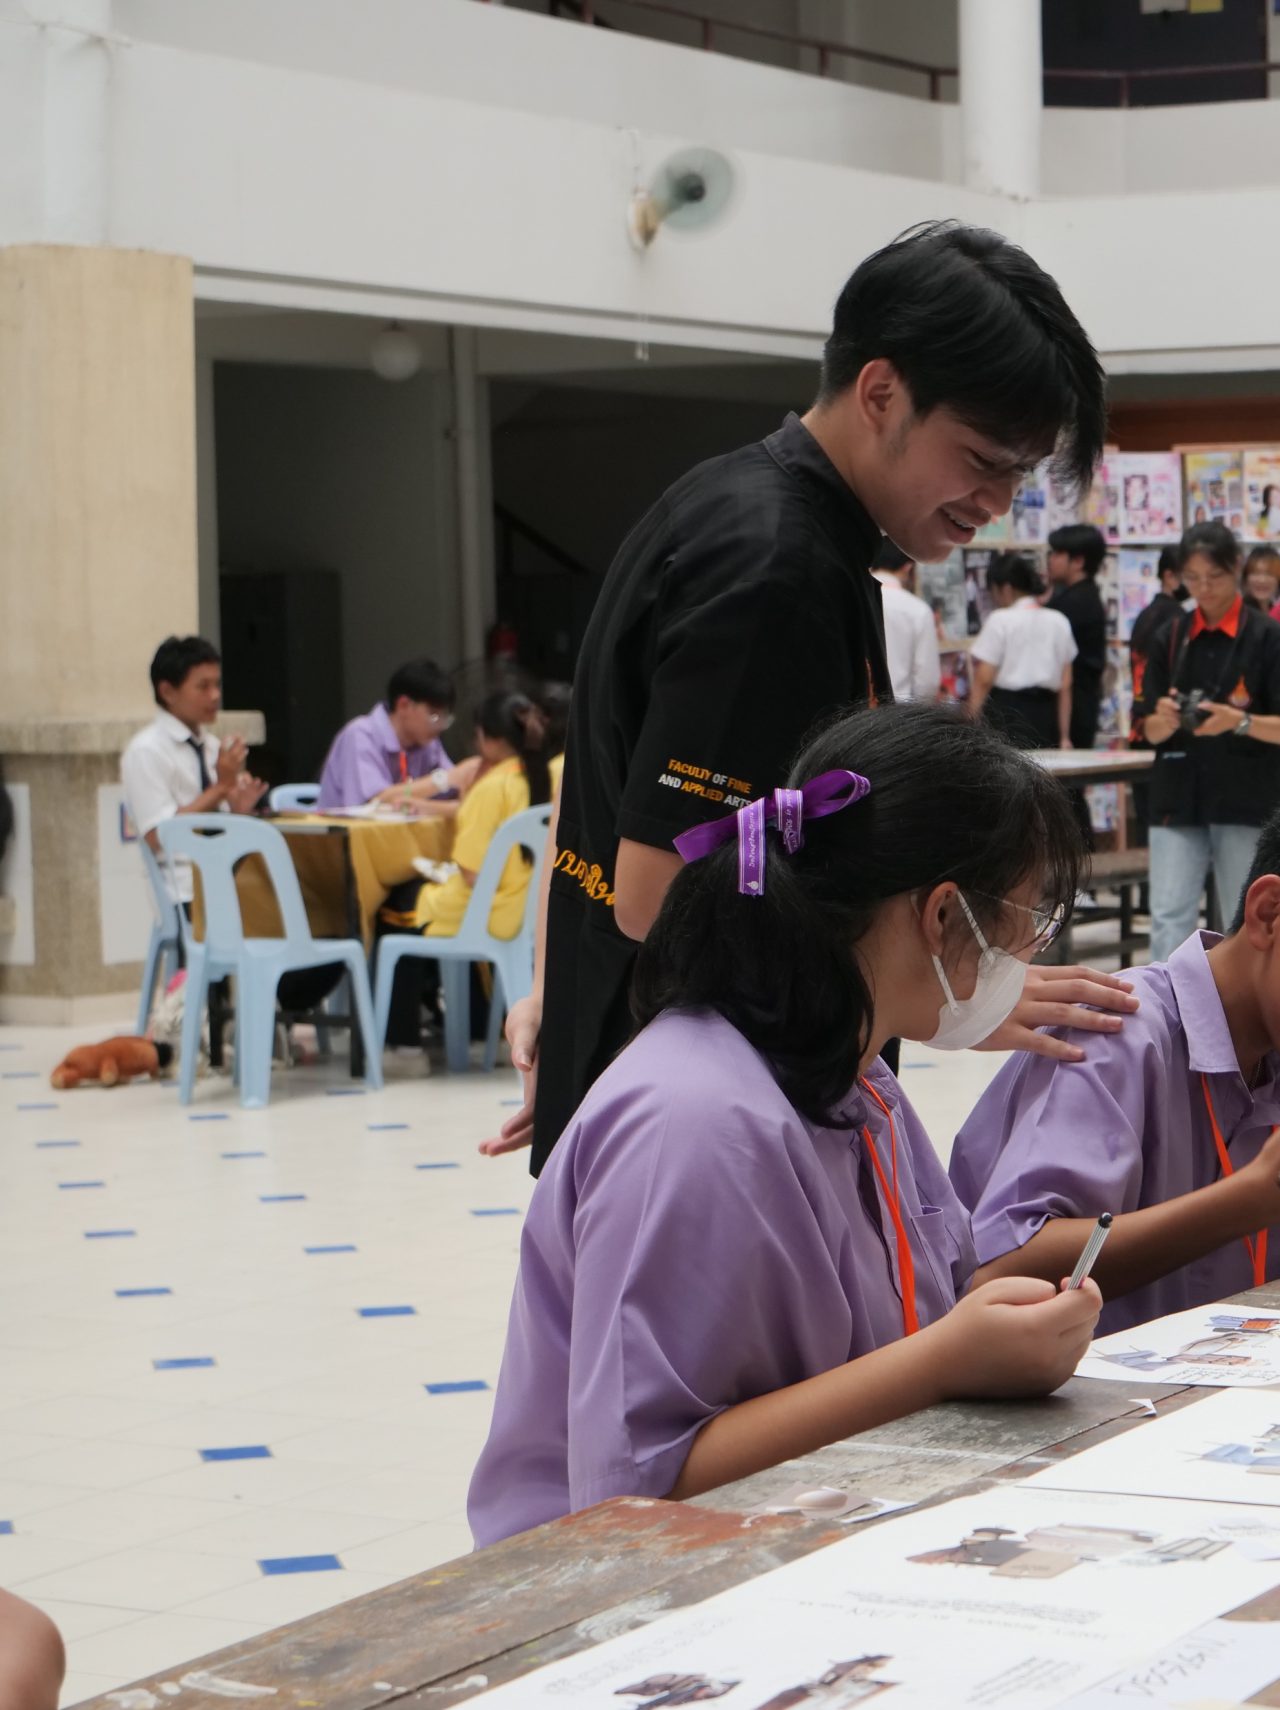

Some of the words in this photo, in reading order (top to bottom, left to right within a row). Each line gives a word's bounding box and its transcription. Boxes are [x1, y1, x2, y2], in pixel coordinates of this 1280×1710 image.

[658, 773, 682, 789] AND
[681, 780, 724, 802] APPLIED
[667, 758, 713, 781] FACULTY
[712, 772, 729, 786] OF
[726, 776, 753, 795] FINE
